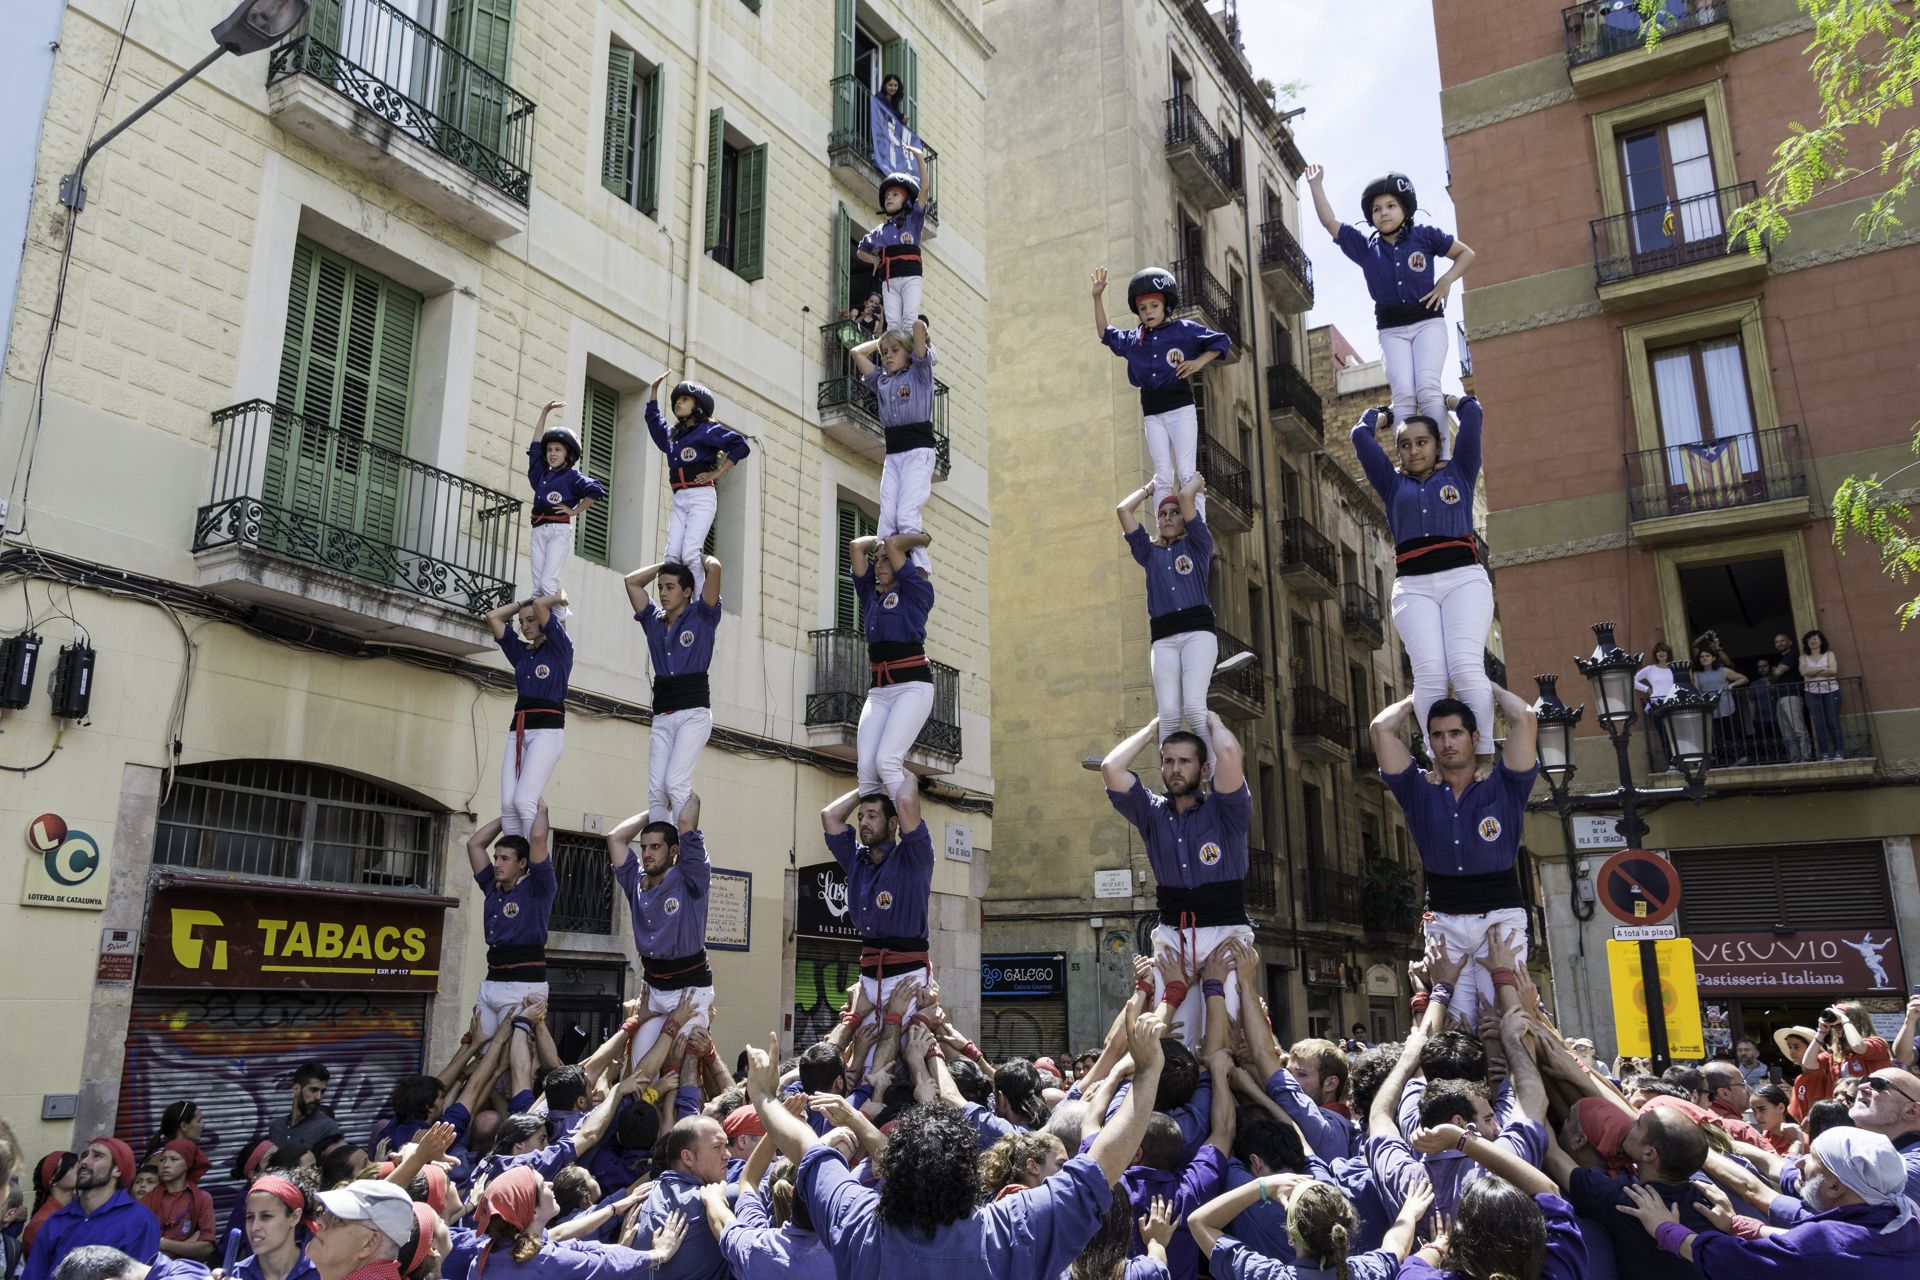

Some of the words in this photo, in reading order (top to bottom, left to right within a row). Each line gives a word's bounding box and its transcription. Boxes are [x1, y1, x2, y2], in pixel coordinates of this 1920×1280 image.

[1592, 836, 1601, 844] DE
[28, 893, 55, 902] LOTERIA
[66, 896, 102, 906] CATALUNYA
[819, 925, 862, 935] BAR-RESTA
[1616, 929, 1623, 937] A
[1641, 928, 1649, 936] la
[1651, 928, 1674, 937] plaça
[257, 918, 426, 962] TABACS
[1692, 941, 1838, 962] VESUVIO
[1003, 967, 1054, 981] GALEGO
[1695, 972, 1778, 986] Pastisseria
[1781, 970, 1844, 985] Italiana
